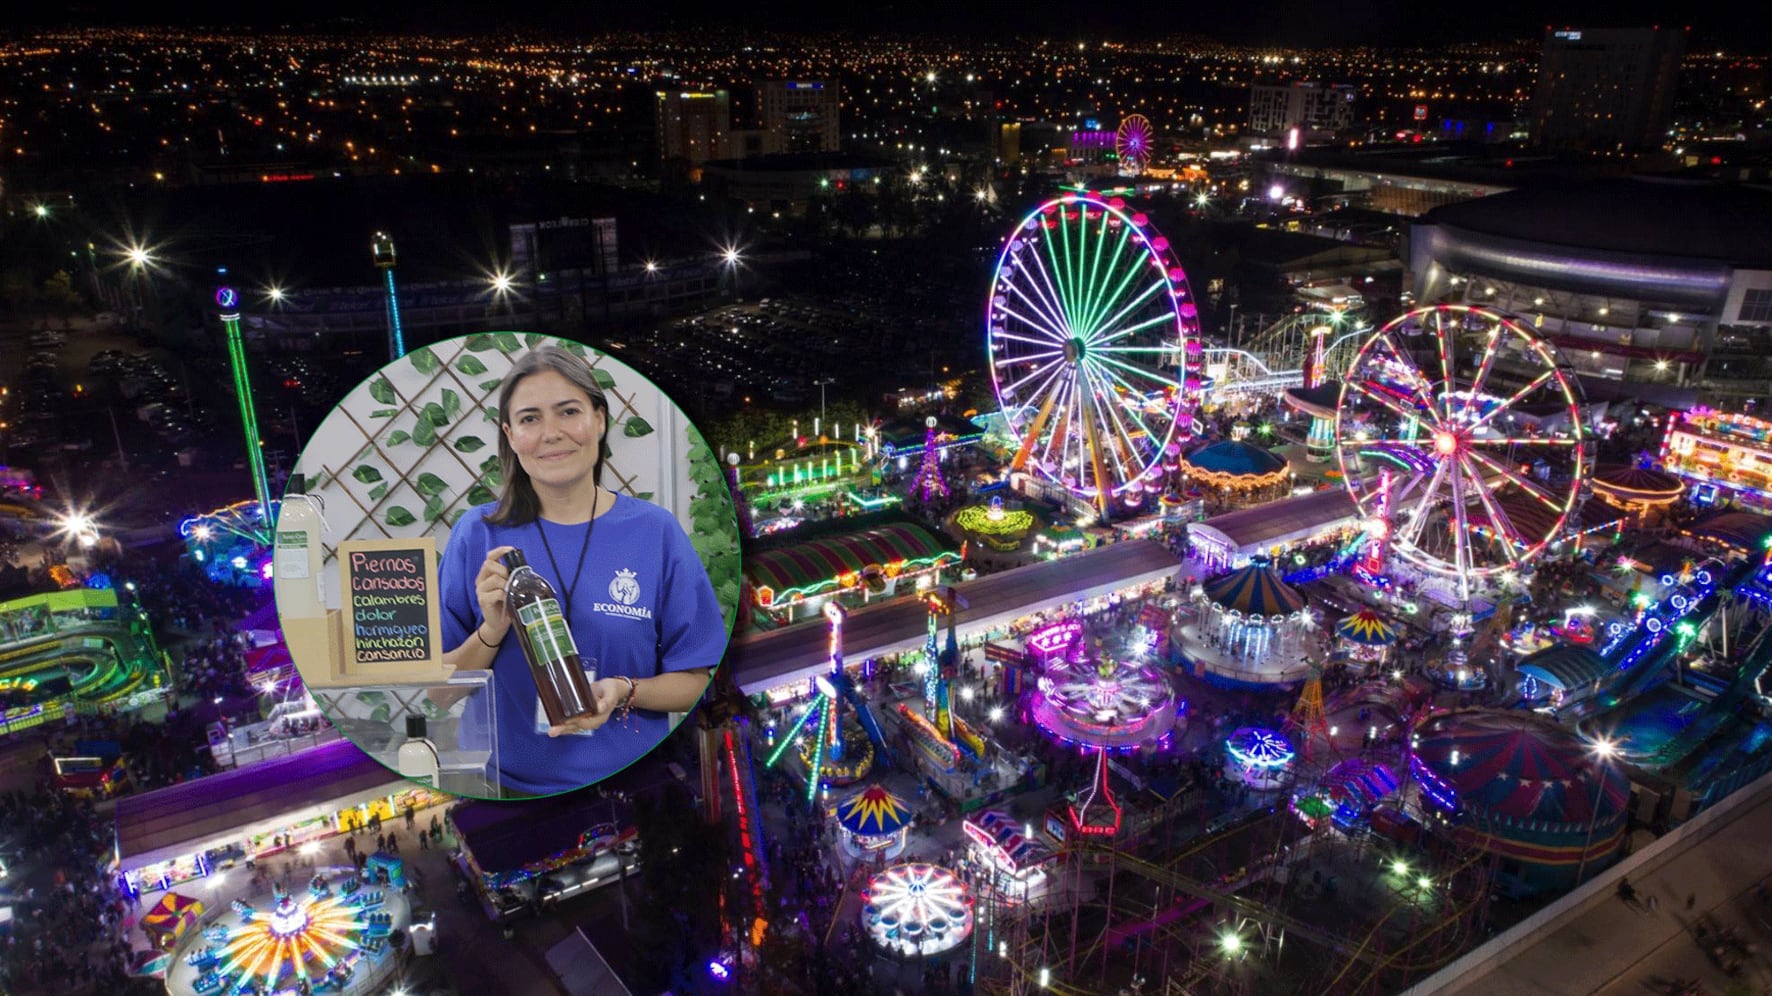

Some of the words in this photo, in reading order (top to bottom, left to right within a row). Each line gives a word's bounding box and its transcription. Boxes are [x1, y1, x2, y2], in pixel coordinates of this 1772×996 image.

[351, 552, 417, 573] Piernas
[355, 608, 397, 622] dolor
[593, 602, 652, 619] ECONOMÍA
[355, 623, 428, 638] hormigueo
[356, 635, 425, 649] hinchazón
